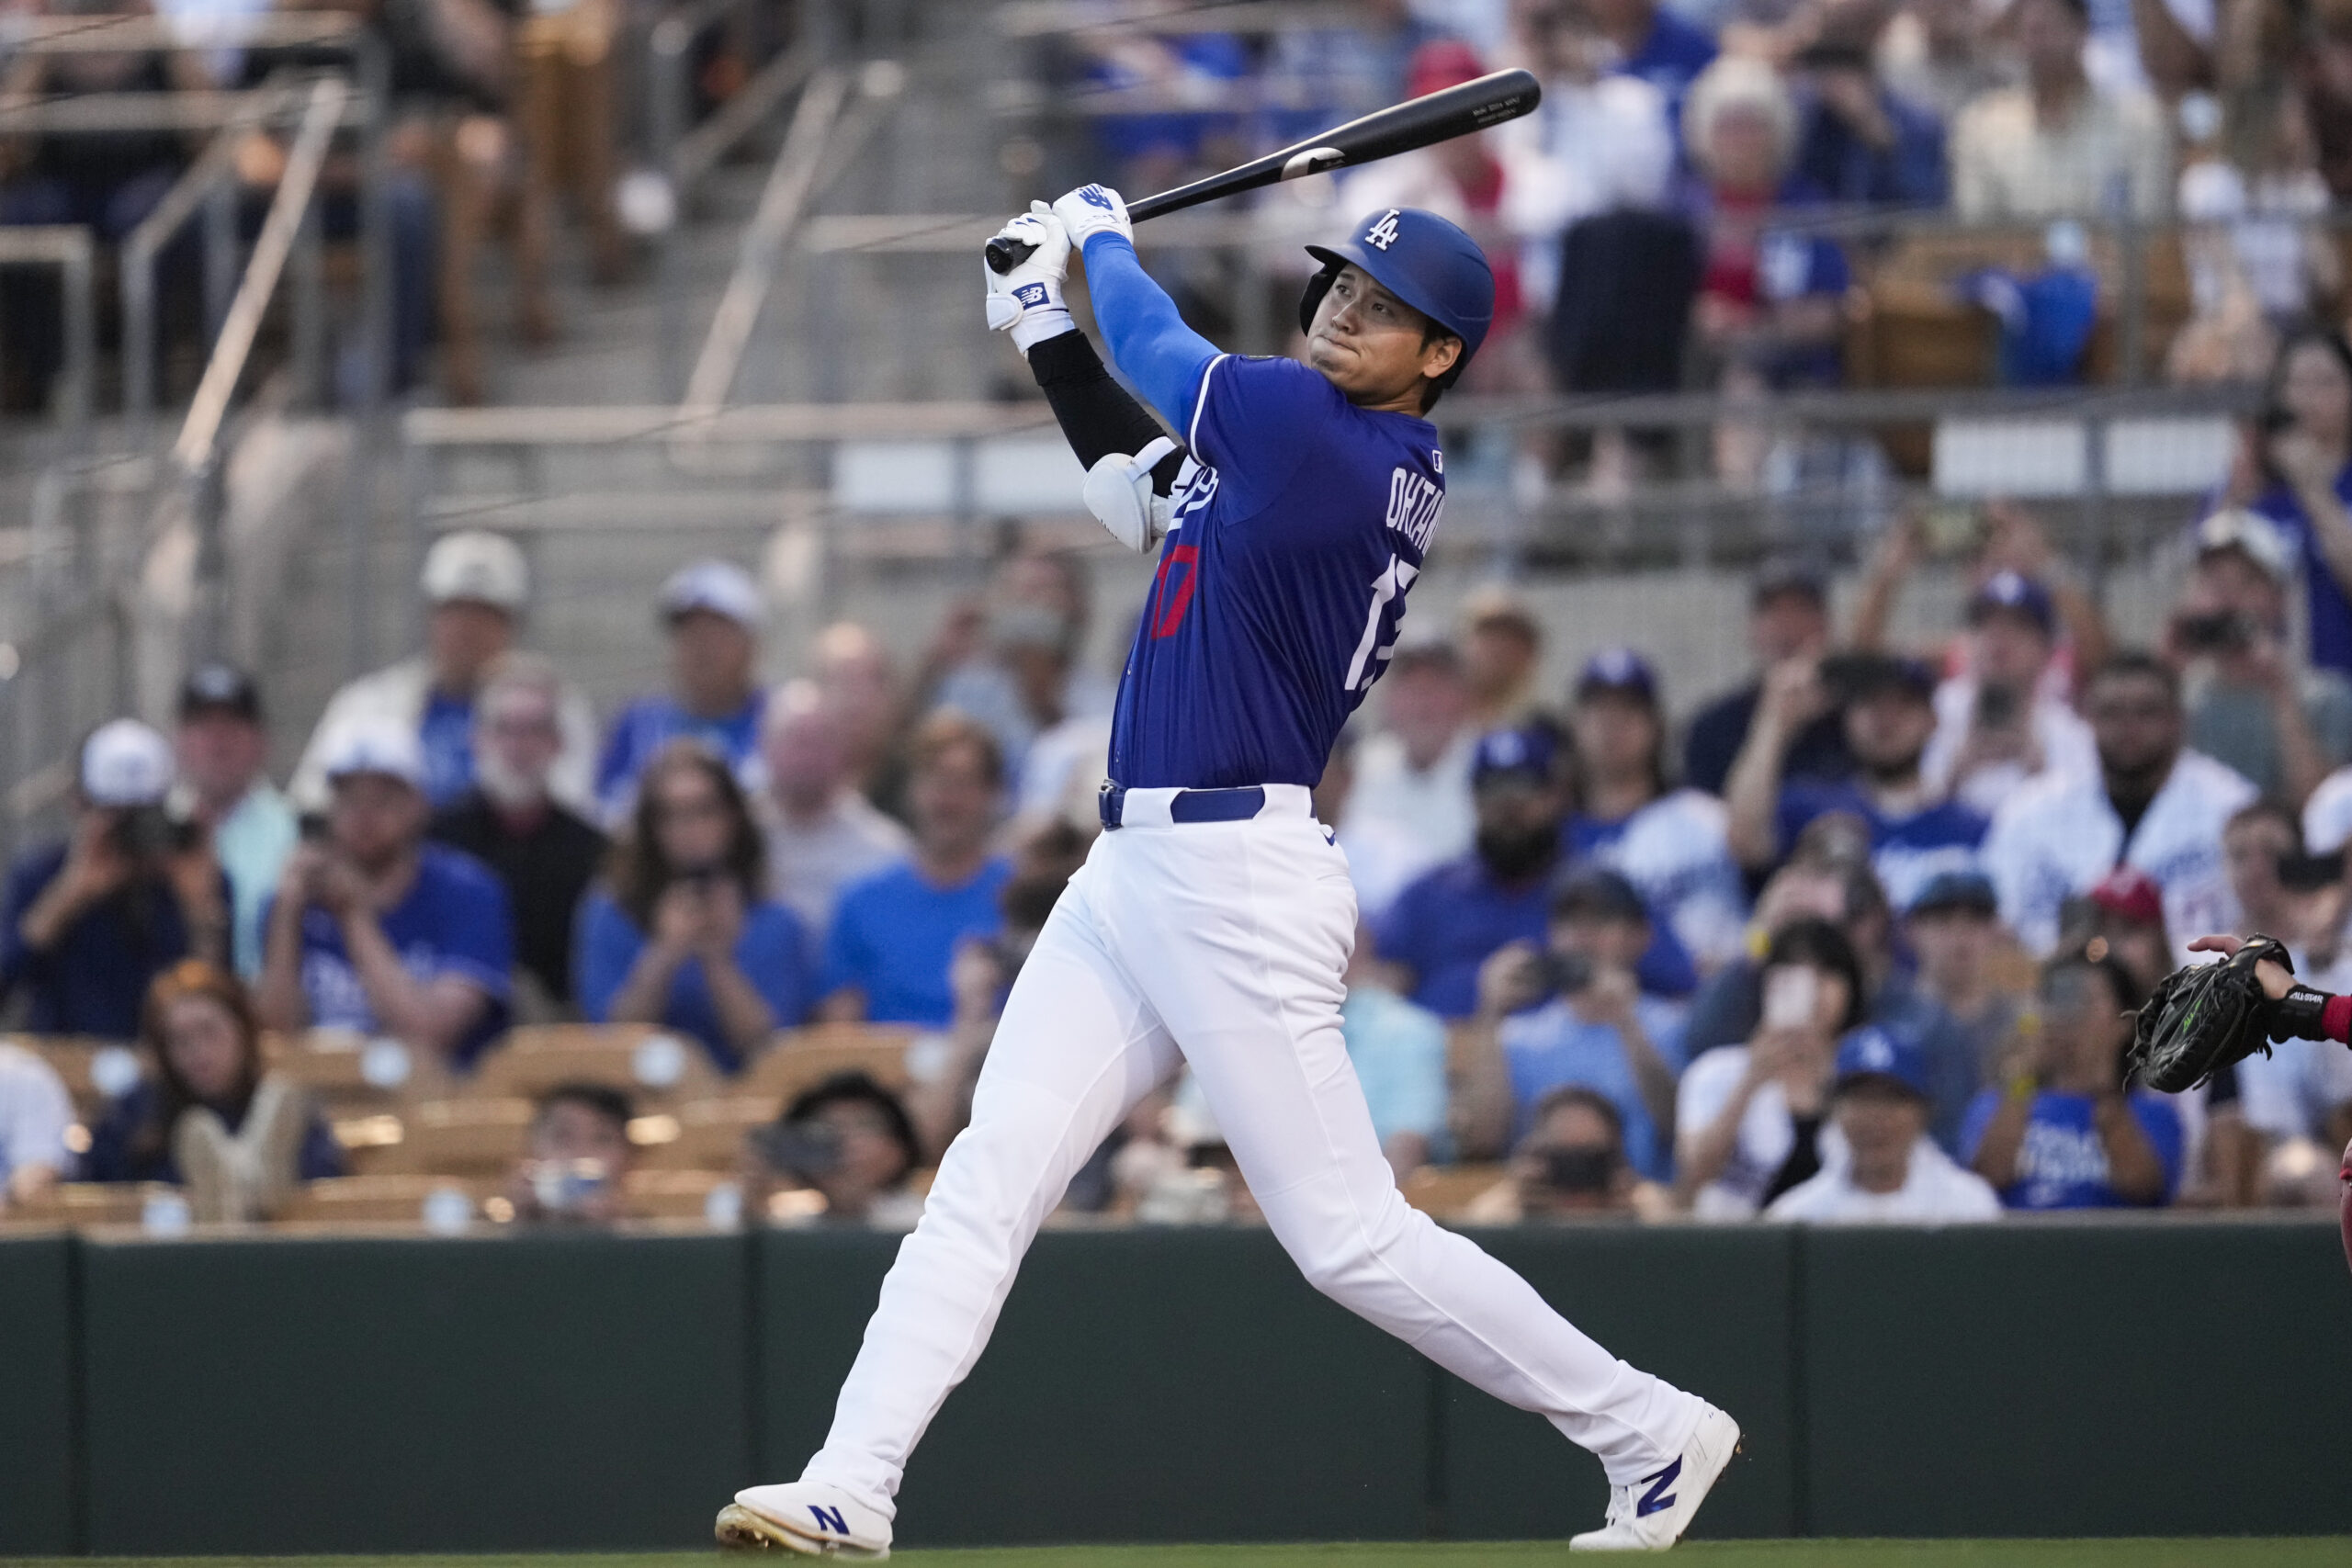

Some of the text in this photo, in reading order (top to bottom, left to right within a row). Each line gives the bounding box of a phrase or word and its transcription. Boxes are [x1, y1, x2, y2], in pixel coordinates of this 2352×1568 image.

[1365, 209, 1399, 250] LA
[1386, 467, 1445, 557] OHTAN
[1150, 544, 1198, 640] 17
[1637, 1453, 1682, 1518] N
[808, 1506, 850, 1535] N
